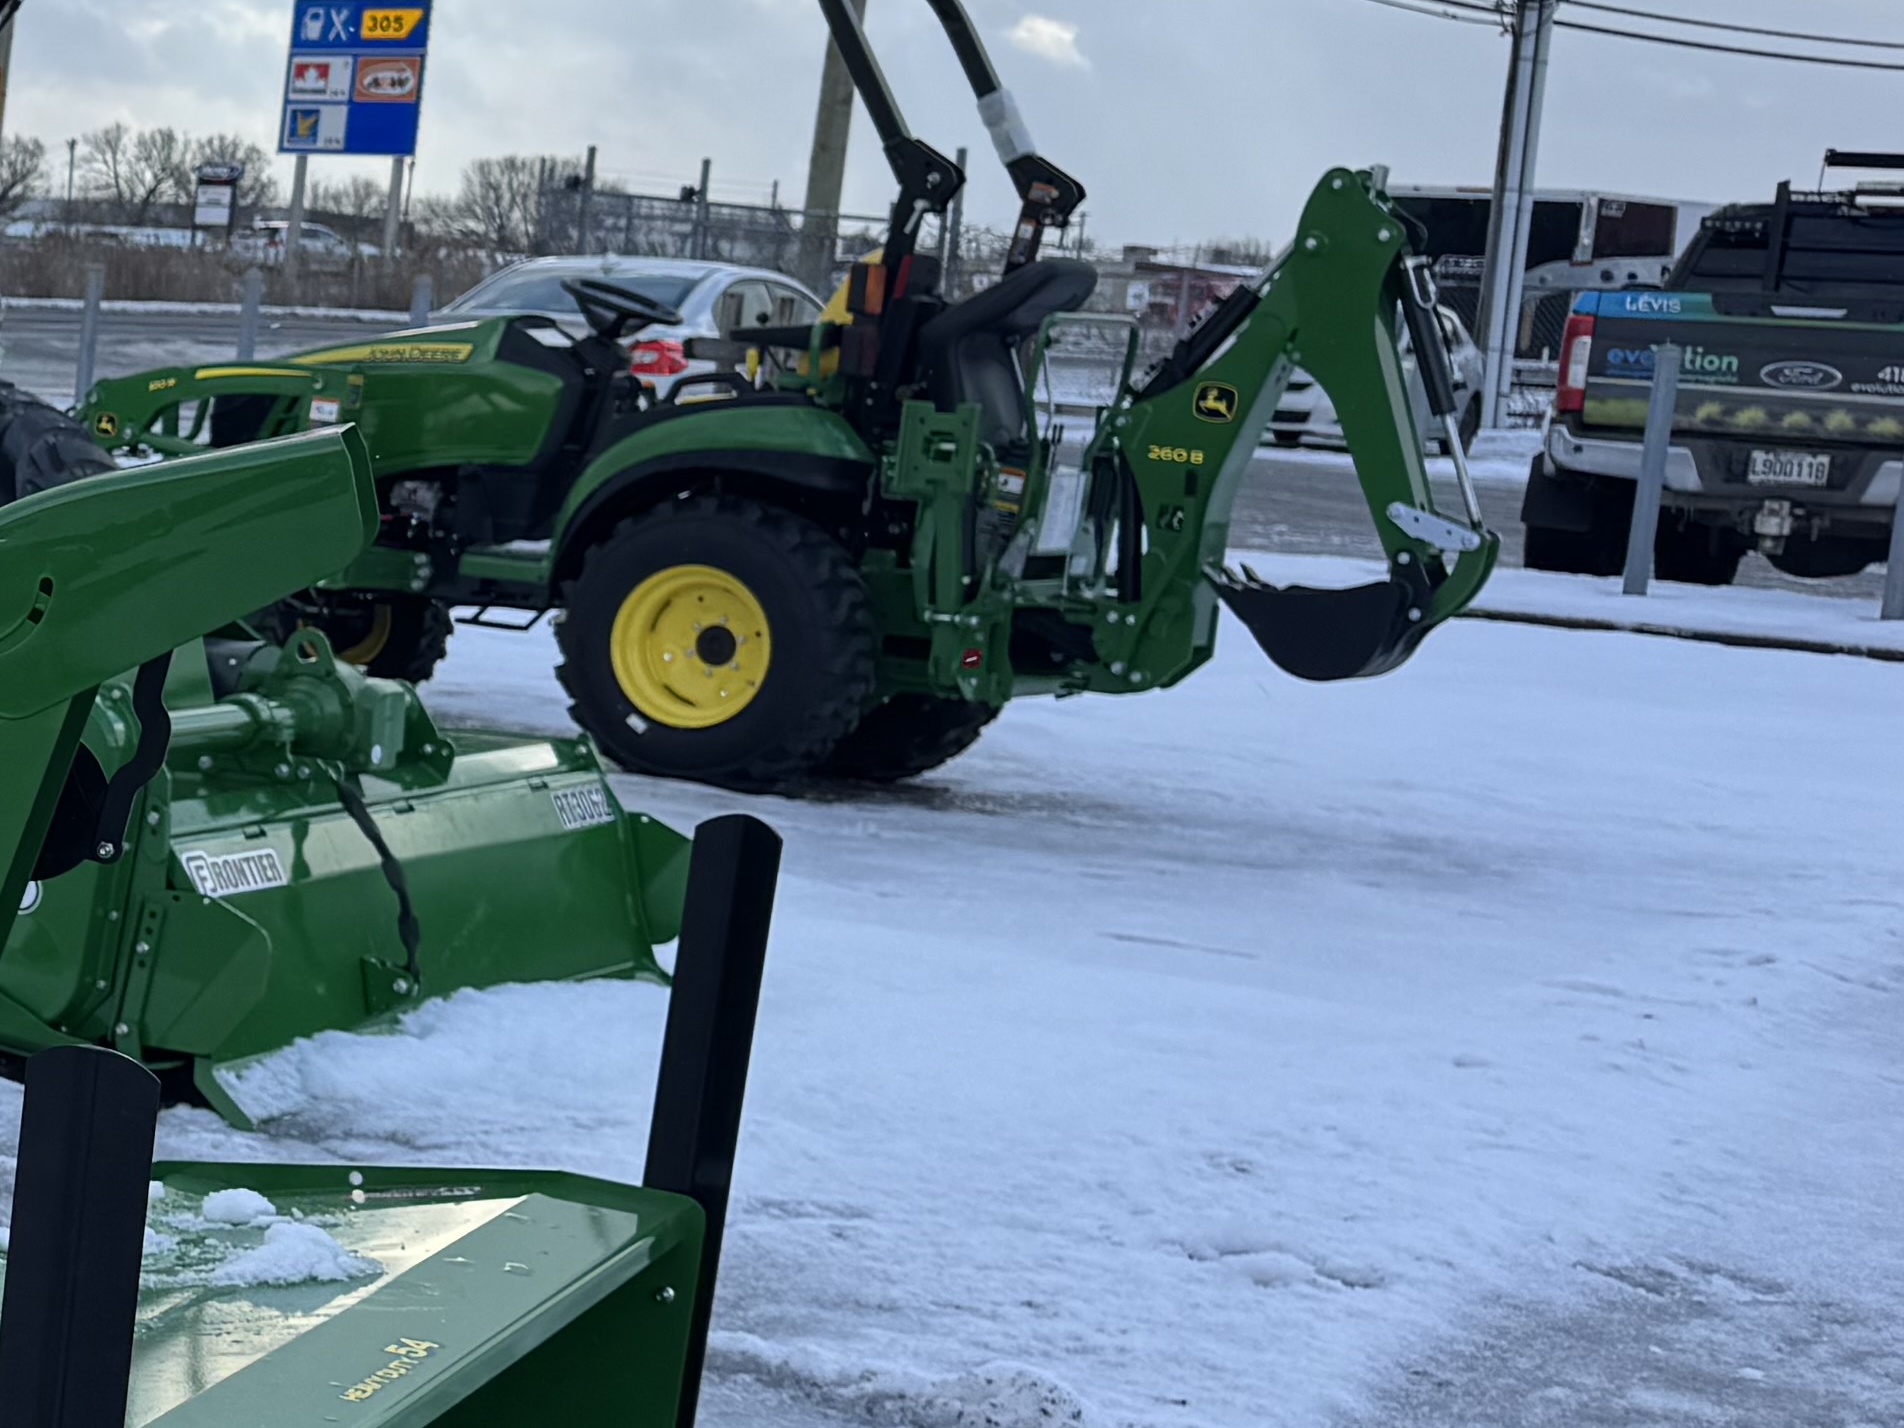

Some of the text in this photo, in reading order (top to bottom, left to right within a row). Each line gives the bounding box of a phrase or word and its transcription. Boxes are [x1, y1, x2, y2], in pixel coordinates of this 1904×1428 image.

[366, 15, 405, 33] 305
[1625, 294, 1682, 314] LÉVIS
[1606, 344, 1739, 373] evotion
[383, 1337, 440, 1358] 54
